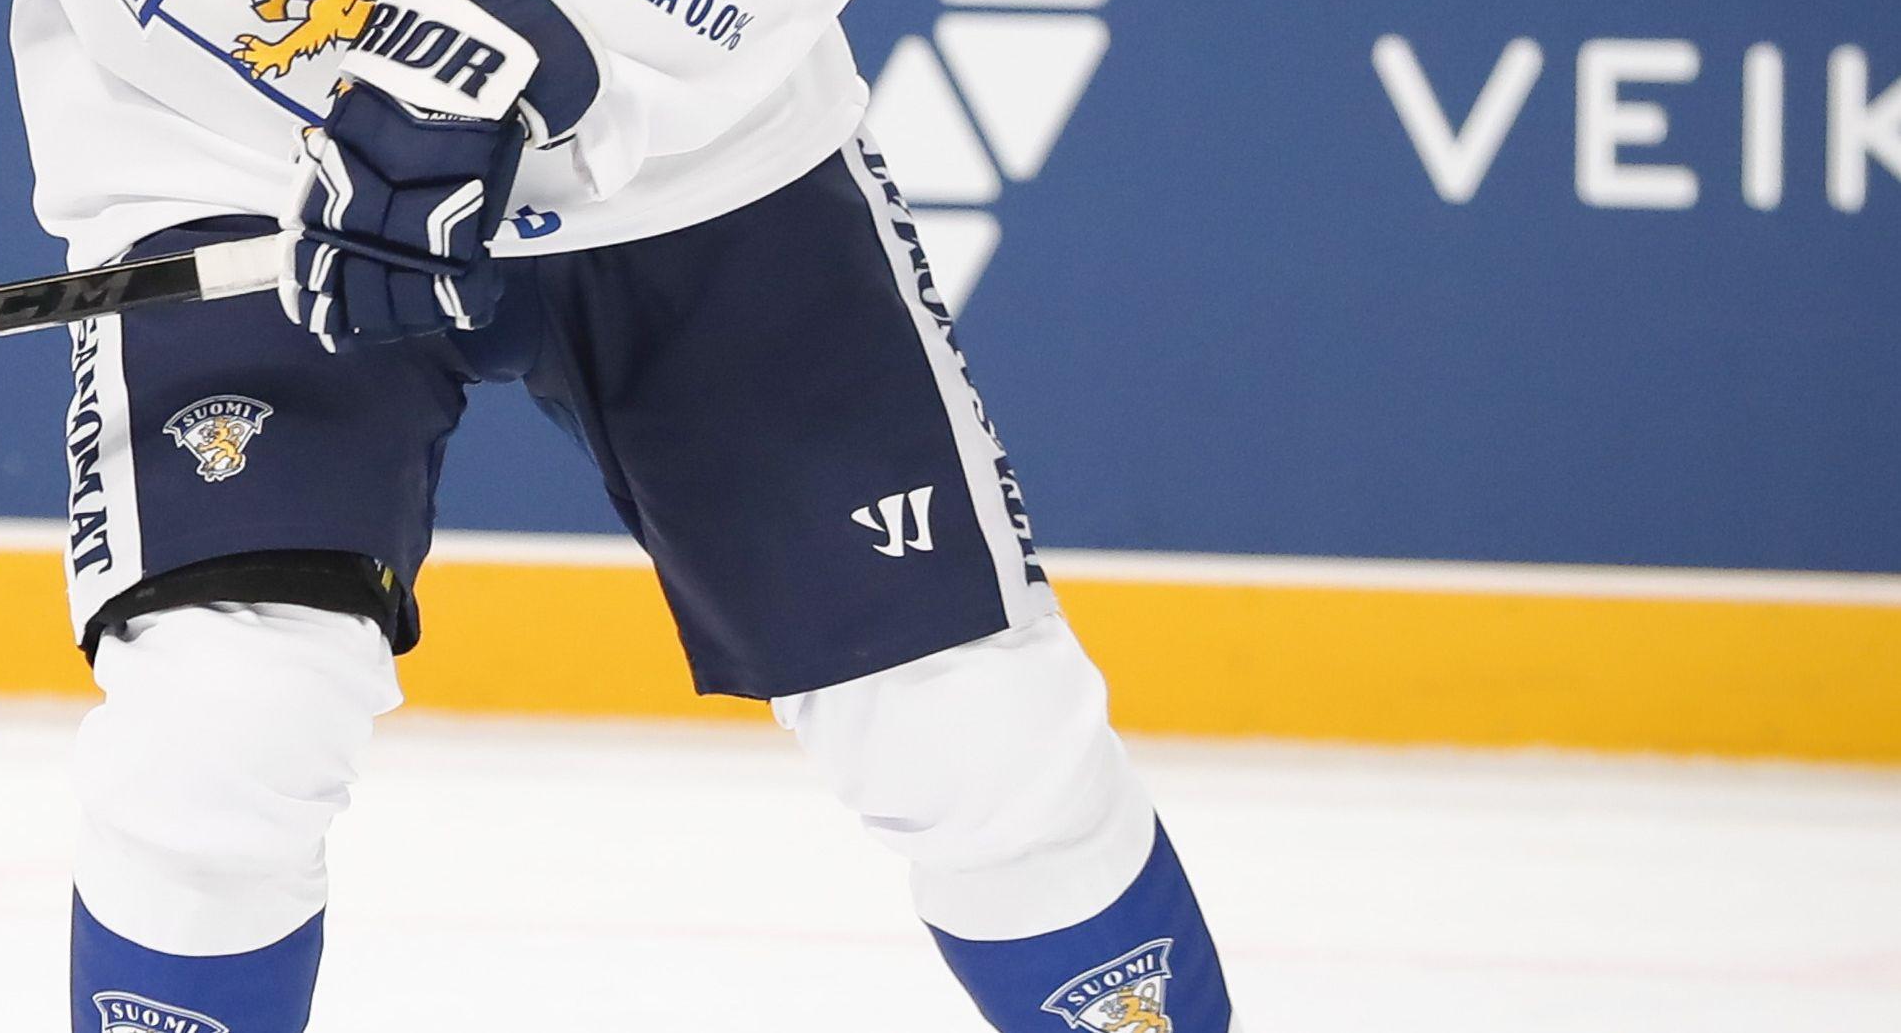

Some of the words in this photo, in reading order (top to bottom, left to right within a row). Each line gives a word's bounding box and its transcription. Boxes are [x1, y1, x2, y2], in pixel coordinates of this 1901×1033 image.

[181, 400, 252, 428] SUOMI
[1066, 954, 1156, 1007] SUOMI
[109, 1001, 199, 1033] SUOMI
